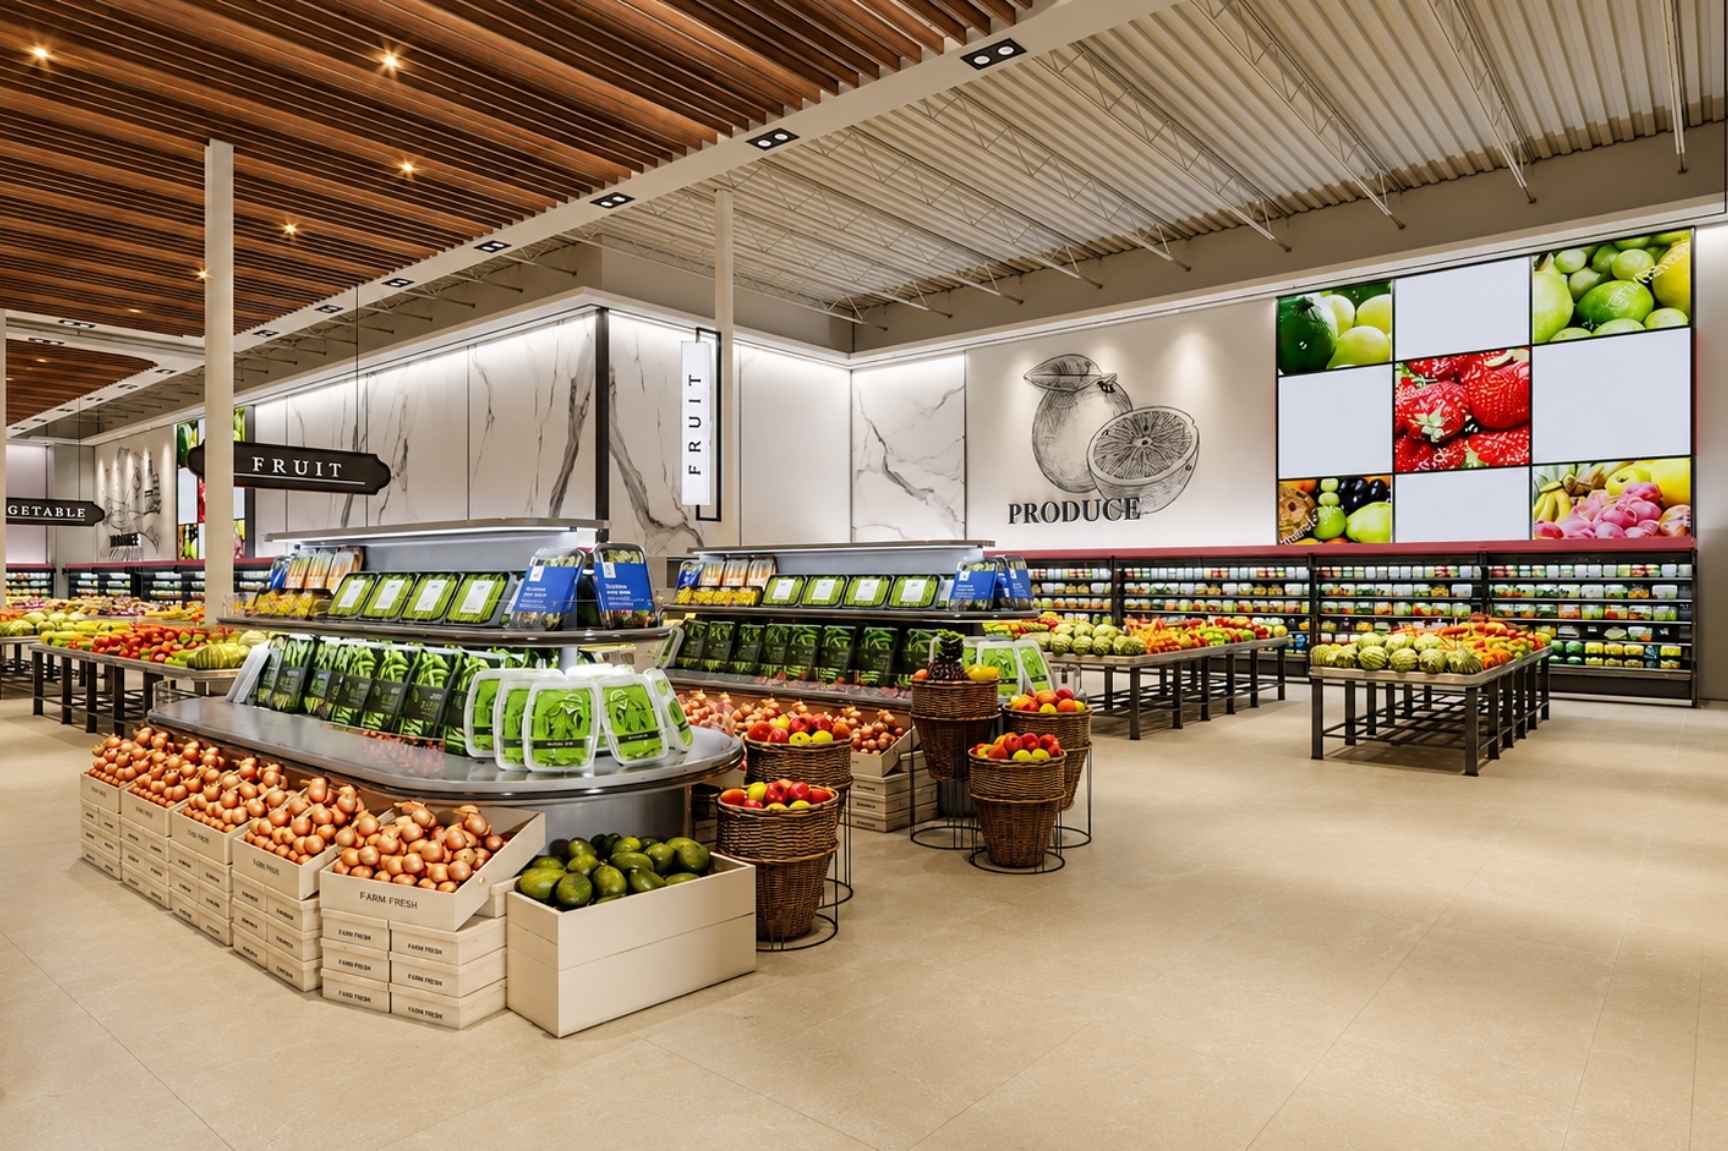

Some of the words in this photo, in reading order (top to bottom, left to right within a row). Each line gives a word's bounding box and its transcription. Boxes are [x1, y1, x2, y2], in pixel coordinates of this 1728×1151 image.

[688, 374, 702, 475] FRUIT
[252, 456, 342, 477] FRUIT
[7, 505, 86, 518] GETABLE
[1008, 497, 1141, 525] PRODUCE
[359, 891, 386, 904] FARM
[389, 897, 418, 909] FRESH
